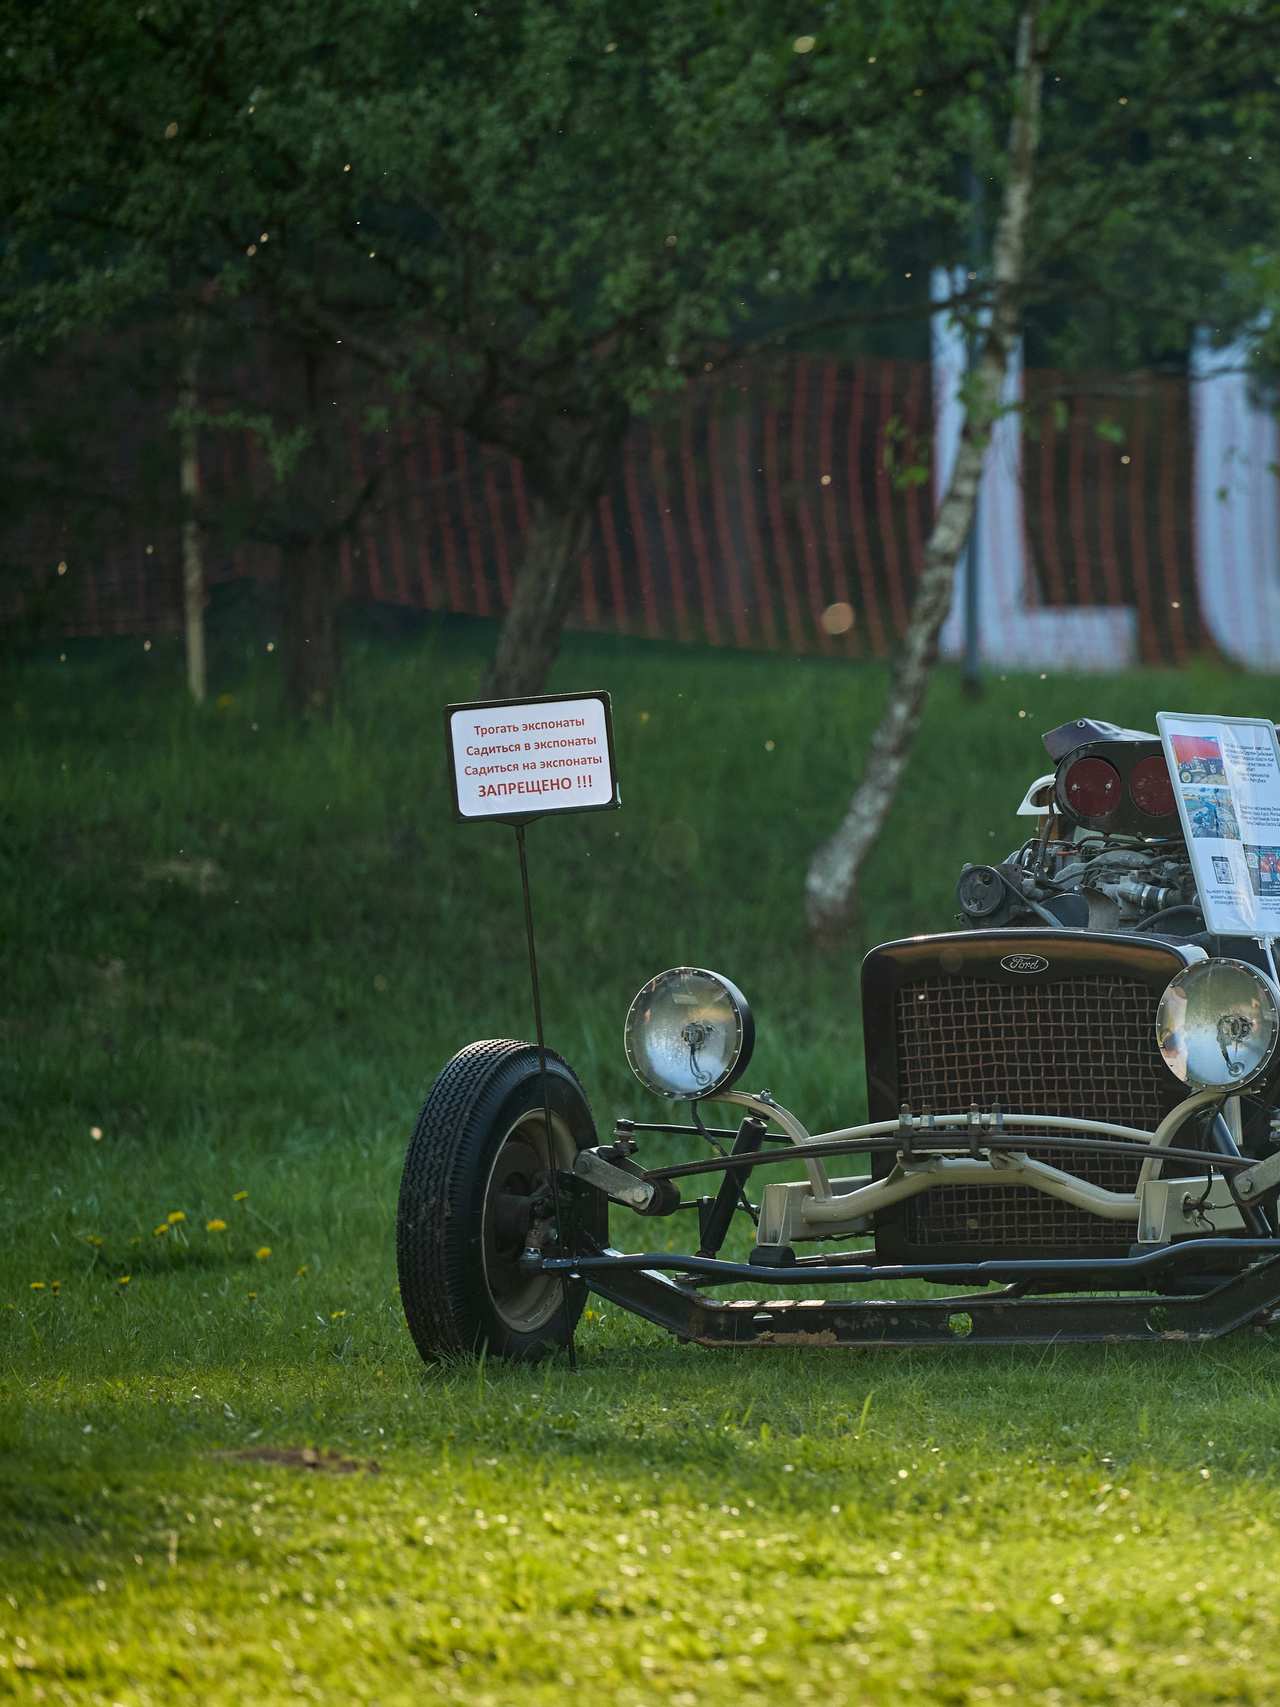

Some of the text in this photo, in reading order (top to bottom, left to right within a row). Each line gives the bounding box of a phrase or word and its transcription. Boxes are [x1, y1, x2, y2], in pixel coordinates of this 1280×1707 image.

[474, 718, 585, 737] Трогать экспонаты
[466, 736, 597, 757] Садиться в экспонаты
[464, 755, 602, 776] Садиться на экспонаты
[478, 774, 593, 797] ЗАПРЕЩЕНО !!!
[1010, 955, 1039, 970] Ford
